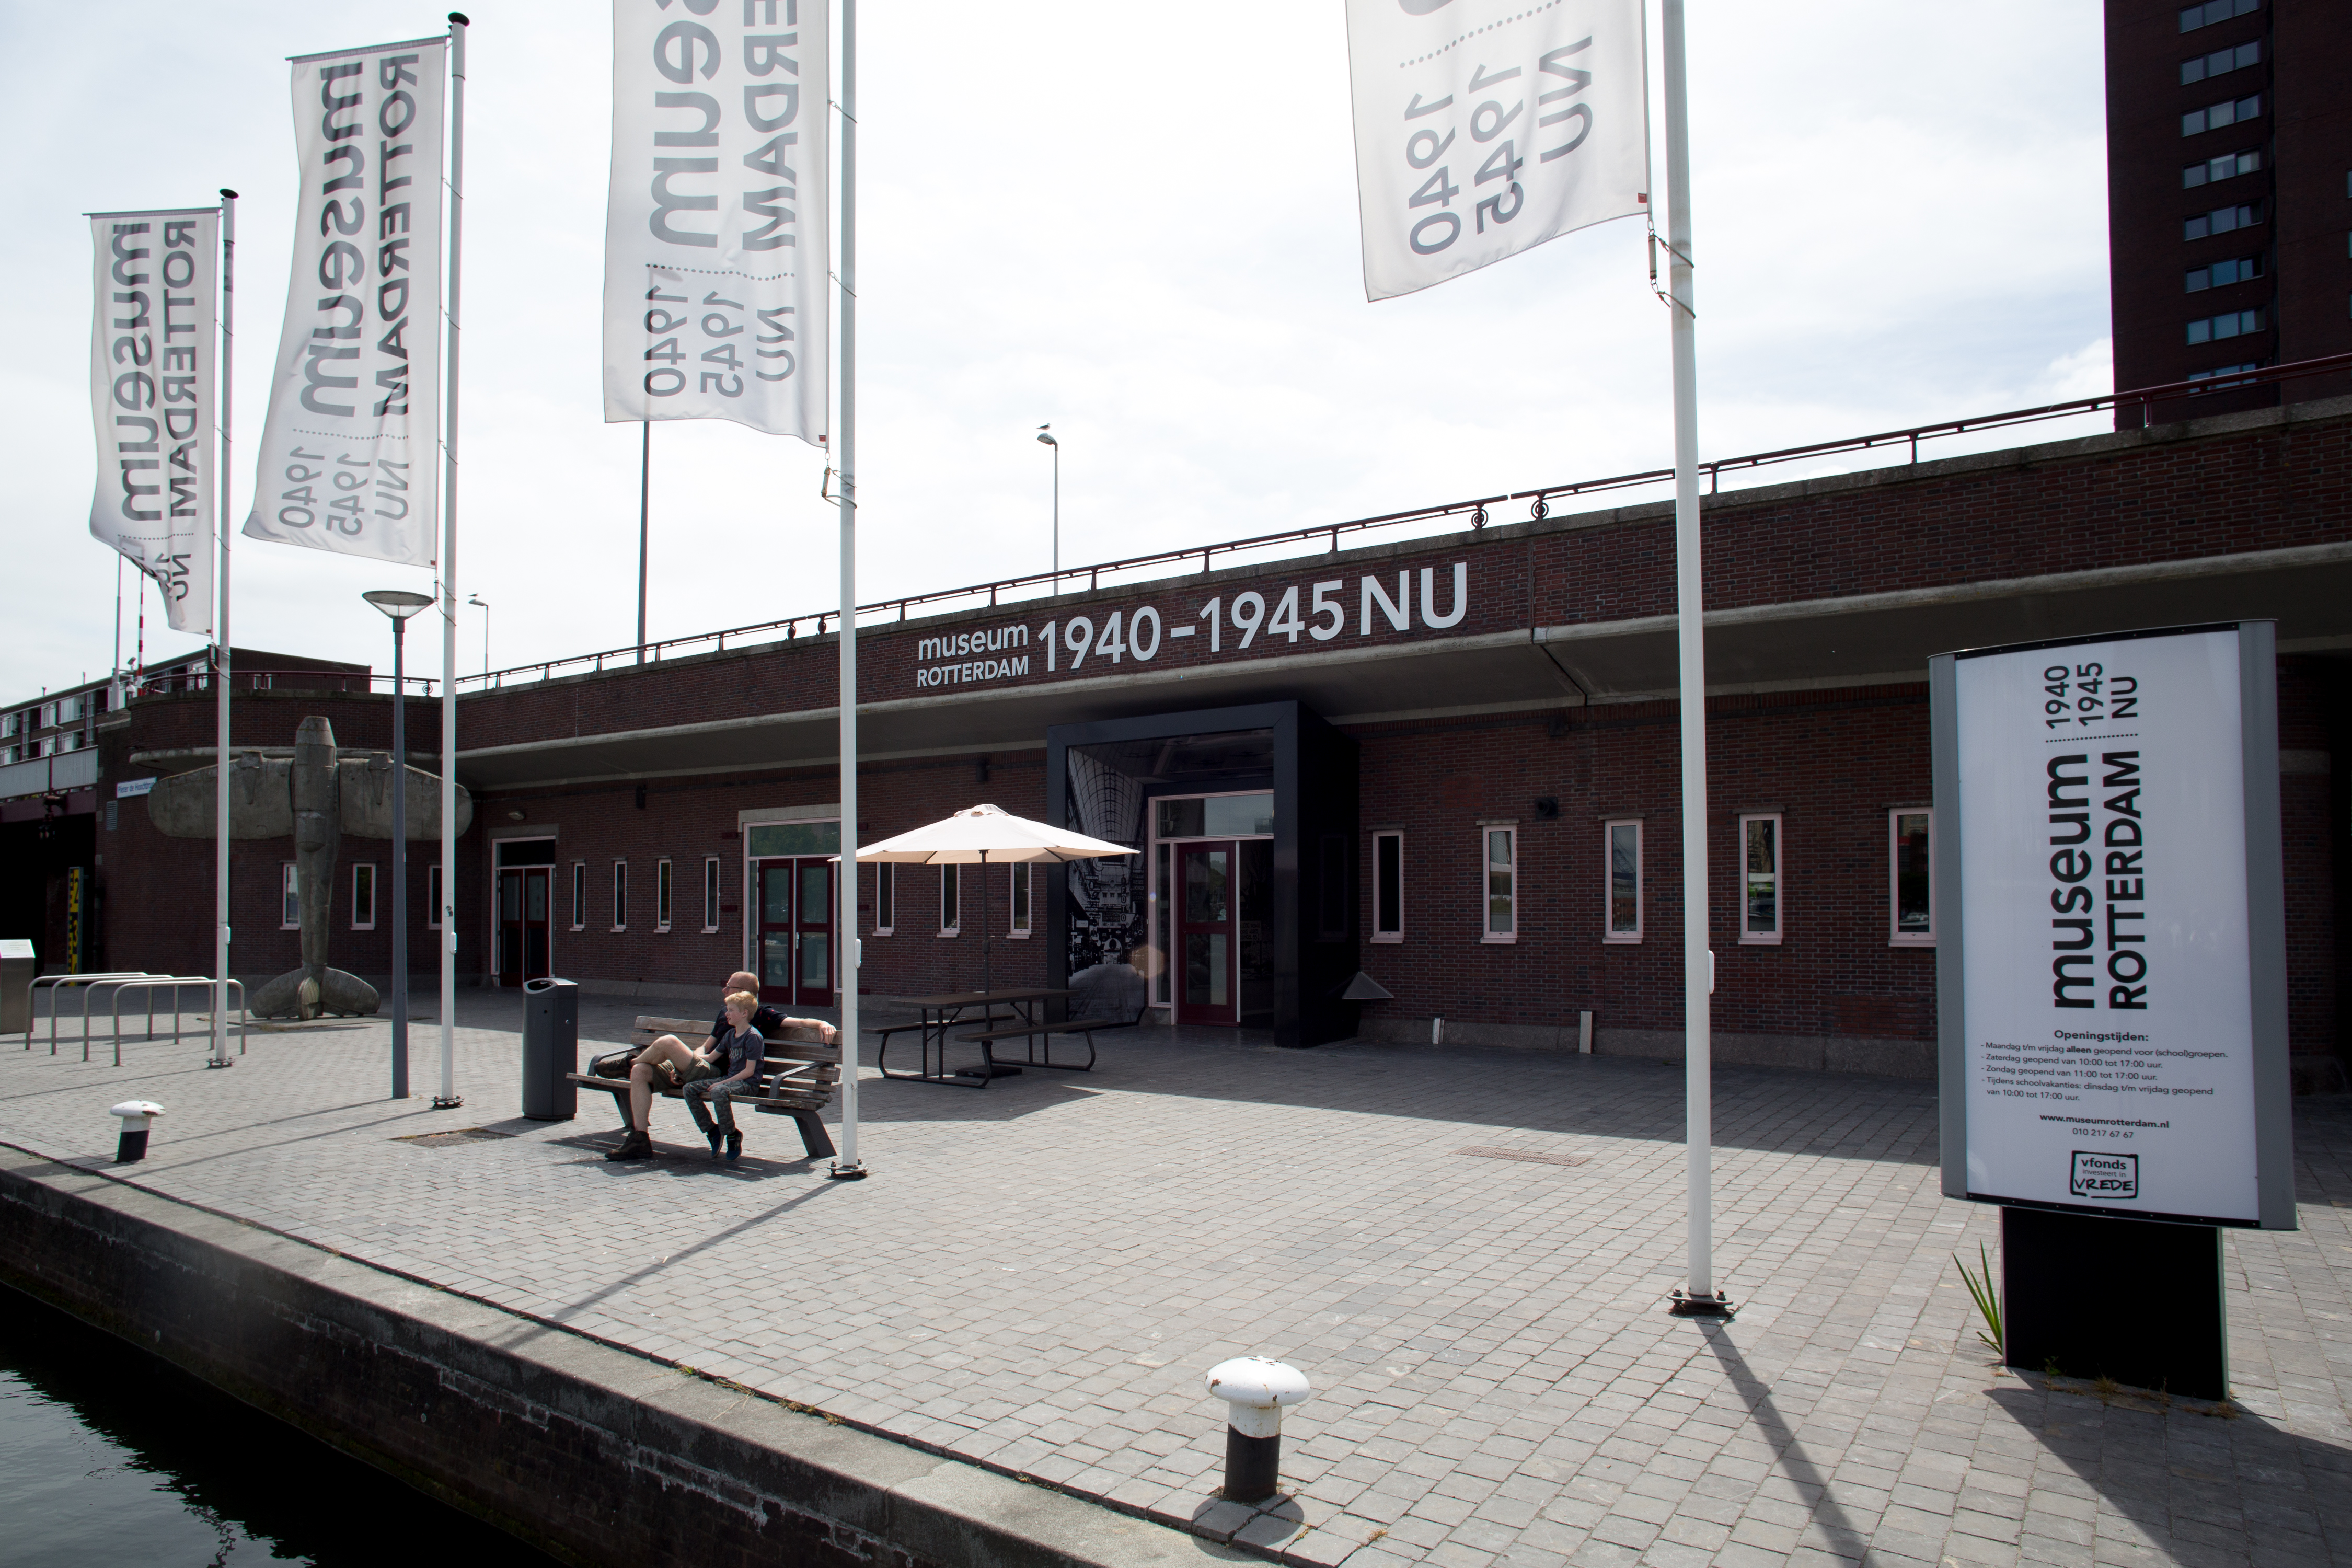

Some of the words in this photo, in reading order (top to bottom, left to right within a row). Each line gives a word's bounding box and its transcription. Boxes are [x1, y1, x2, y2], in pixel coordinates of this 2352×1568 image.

[1361, 562, 1467, 636] NU
[918, 624, 1029, 661] museum
[917, 655, 1029, 688] ROTTERDAM
[2044, 665, 2070, 729] 1940
[2077, 662, 2104, 727] 1945
[2110, 676, 2138, 719] NU
[2046, 754, 2095, 1009] museum
[2102, 751, 2147, 1009] ROTTERDAM
[2054, 1030, 2149, 1042] Openingstijden:
[1986, 1042, 2020, 1052] Maandag
[2038, 1045, 2064, 1053] vrijdag
[2155, 1049, 2228, 1059] (school)groepen.
[1986, 1054, 2020, 1063] Zaterdag
[1986, 1065, 2015, 1075] Zondag
[1987, 1077, 2014, 1085] Tijdens
[2016, 1079, 2081, 1089] schoolvakanties:
[2084, 1082, 2118, 1092] dinsdag
[2139, 1085, 2169, 1095] vrijdag
[2172, 1088, 2213, 1096] geopend
[2039, 1114, 2169, 1128] www.museumrotterdam.nl
[2081, 1158, 2127, 1170] vfonds
[2082, 1169, 2116, 1177] investeert
[2074, 1178, 2134, 1191] VREDE
